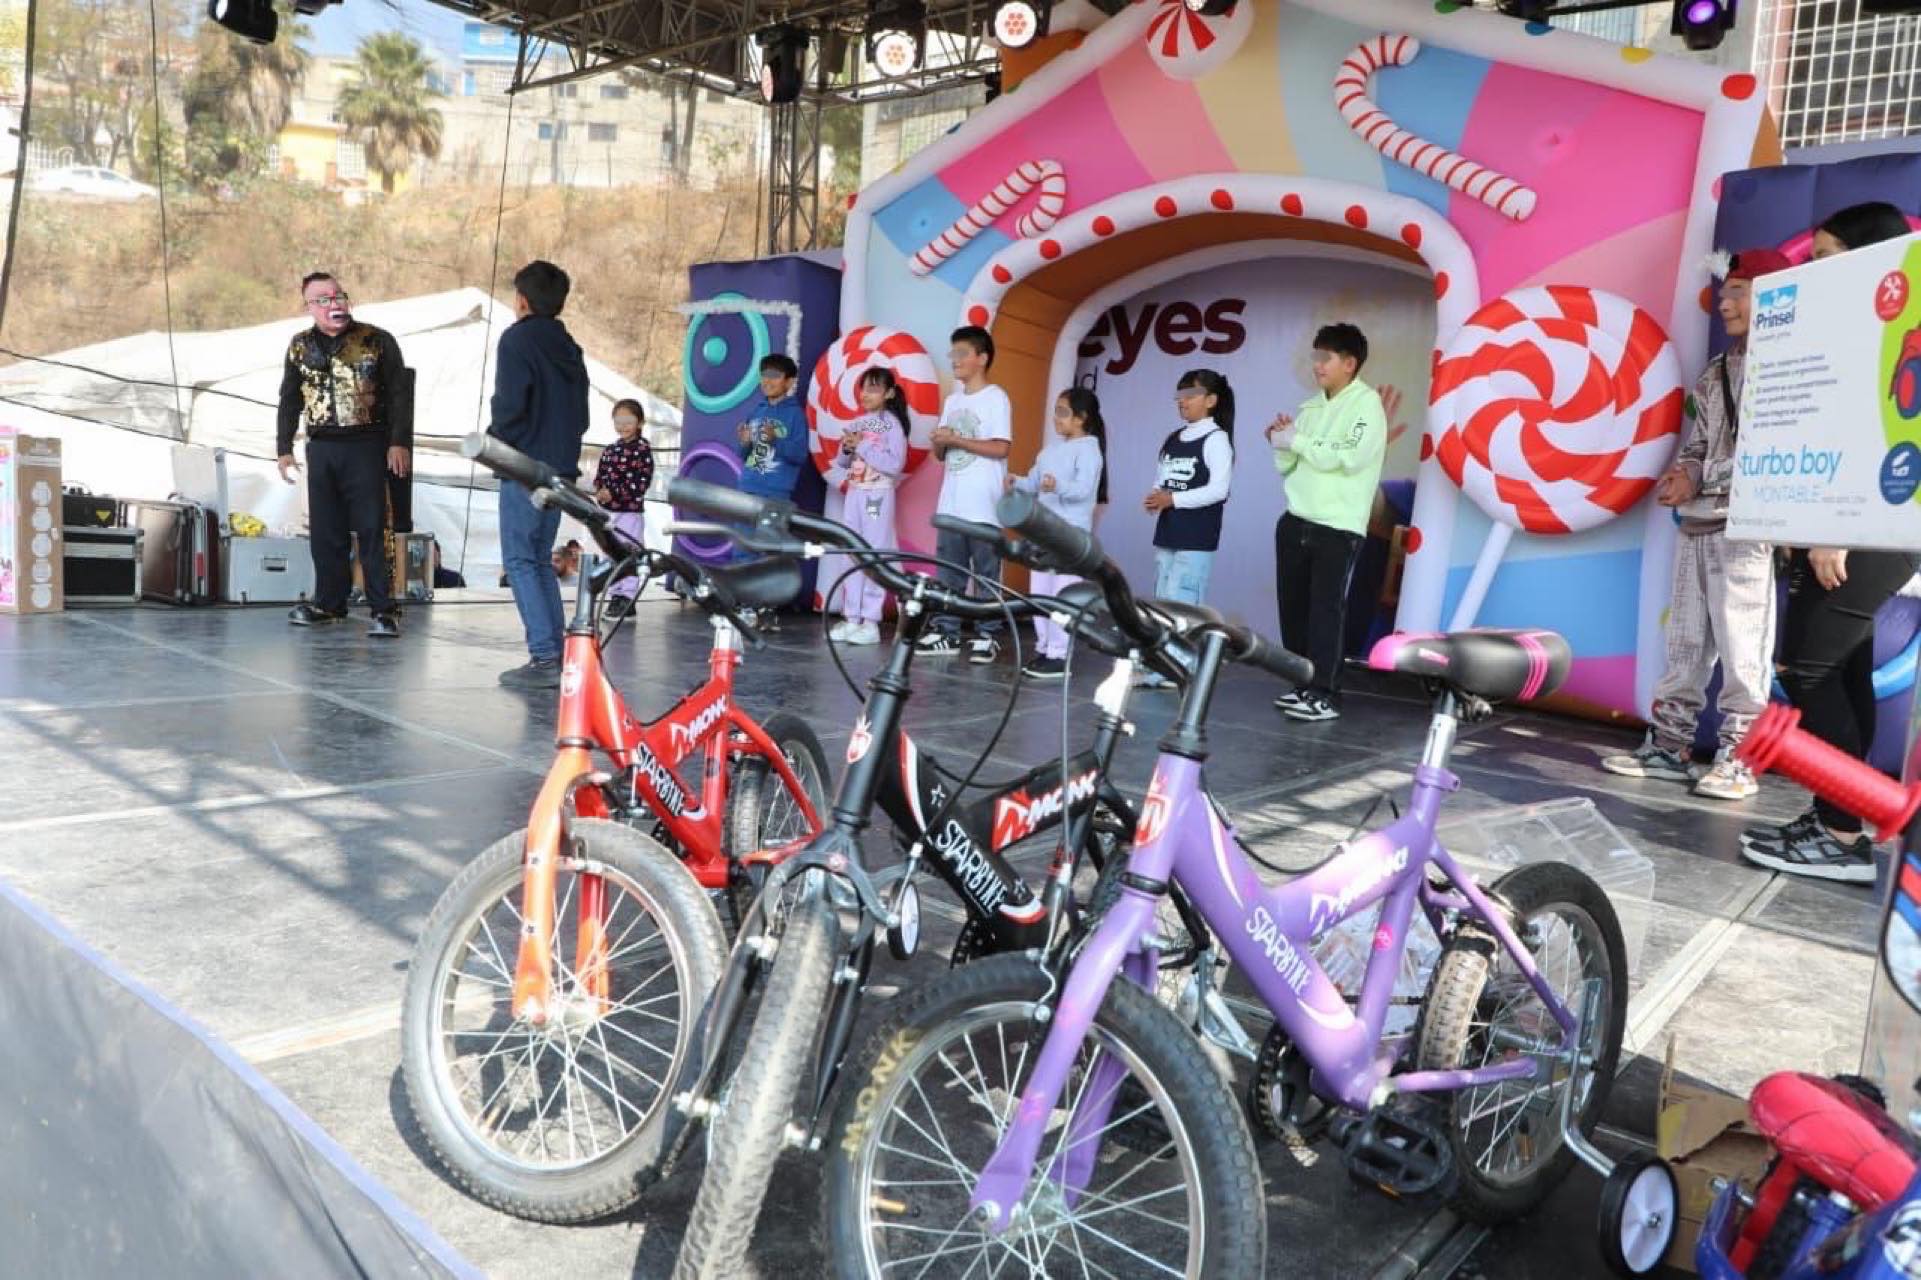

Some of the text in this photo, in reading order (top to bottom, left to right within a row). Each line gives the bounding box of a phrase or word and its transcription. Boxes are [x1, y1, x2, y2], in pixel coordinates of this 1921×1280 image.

[1756, 306, 1796, 330] Prinsel
[1741, 443, 1842, 483] turbo boy
[637, 742, 685, 817] STARBIKE
[935, 818, 1008, 913] STARBIKE
[1245, 906, 1313, 1001] STARBIKE
